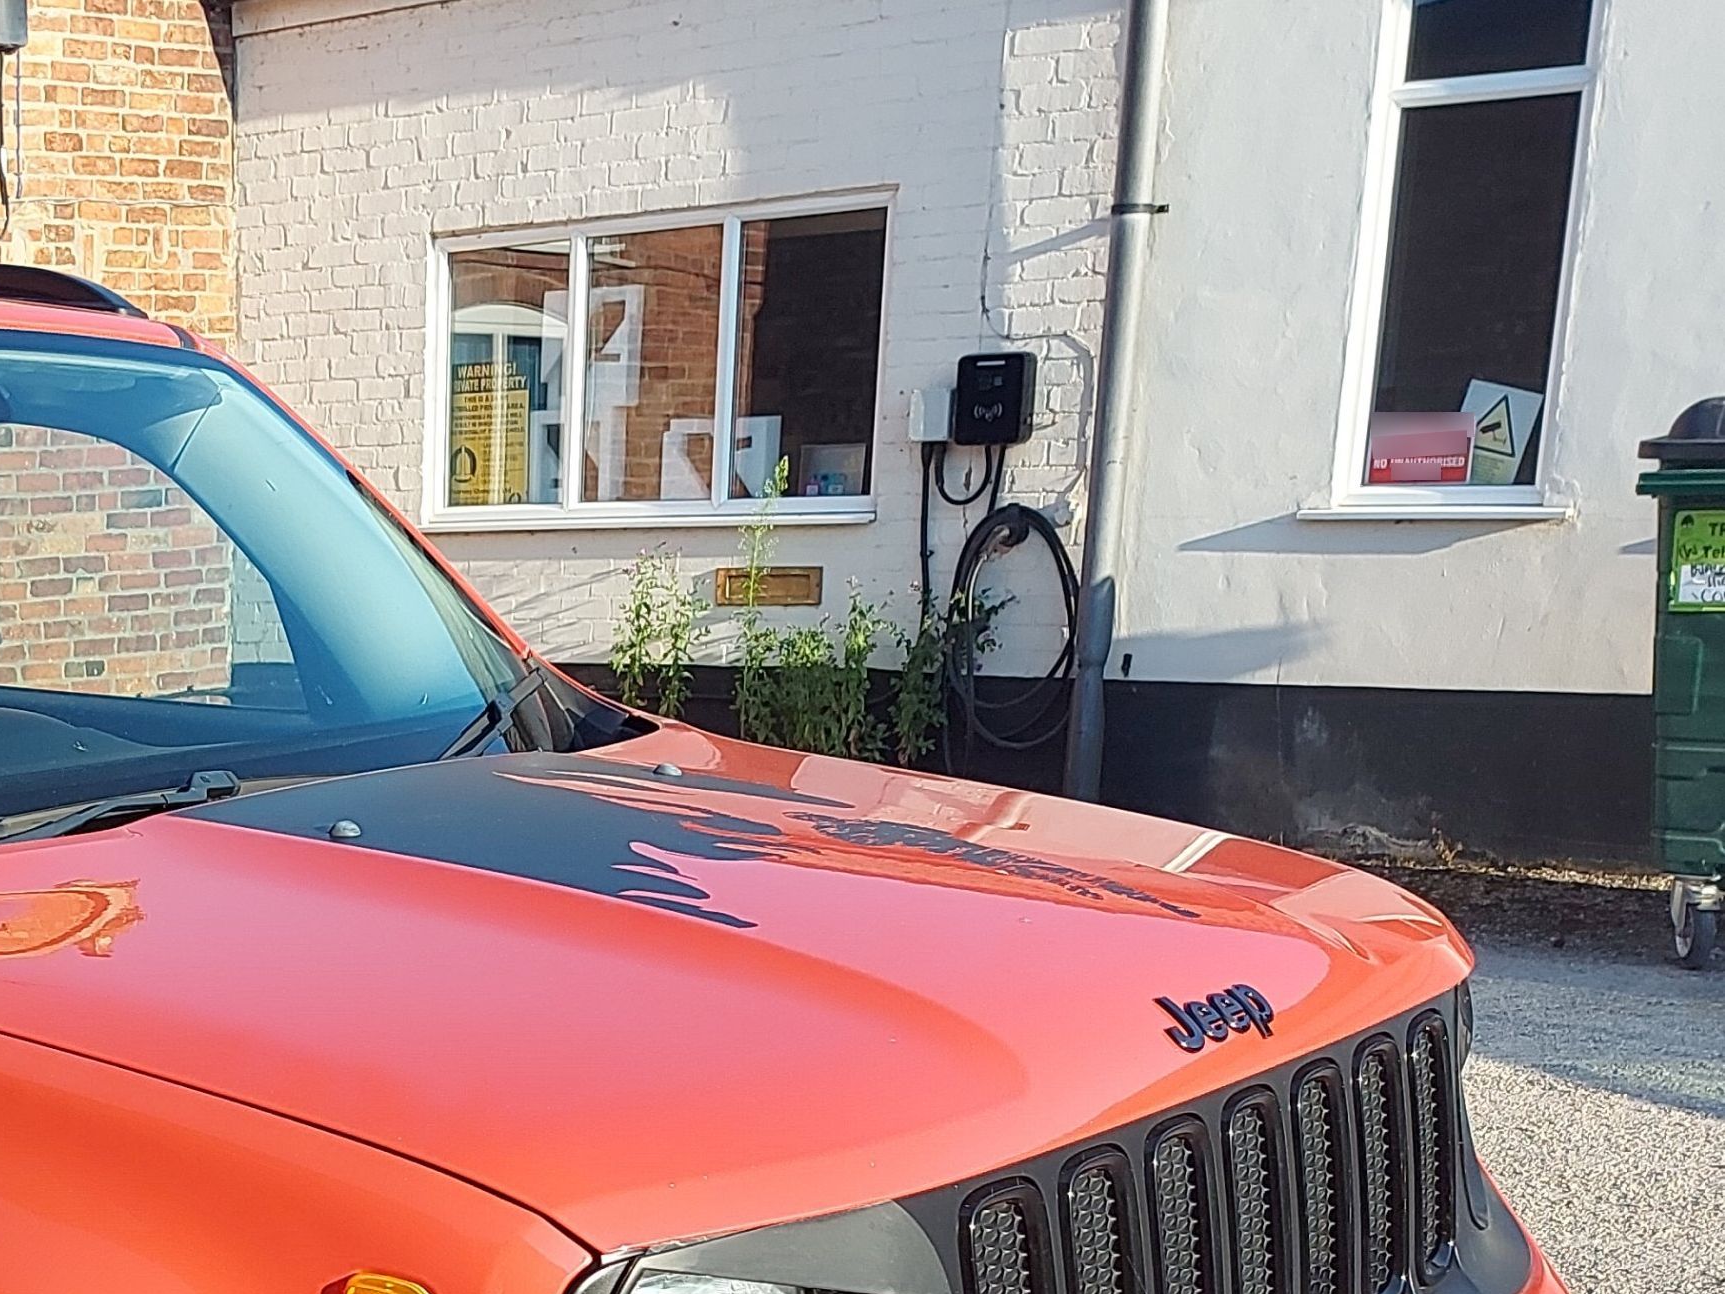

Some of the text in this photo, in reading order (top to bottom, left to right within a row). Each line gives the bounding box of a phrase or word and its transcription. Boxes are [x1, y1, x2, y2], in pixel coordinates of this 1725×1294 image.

[457, 362, 517, 379] WARNING!
[480, 376, 527, 391] PROERTY
[1373, 458, 1388, 469] NO
[1152, 984, 1274, 1053] Jeep
